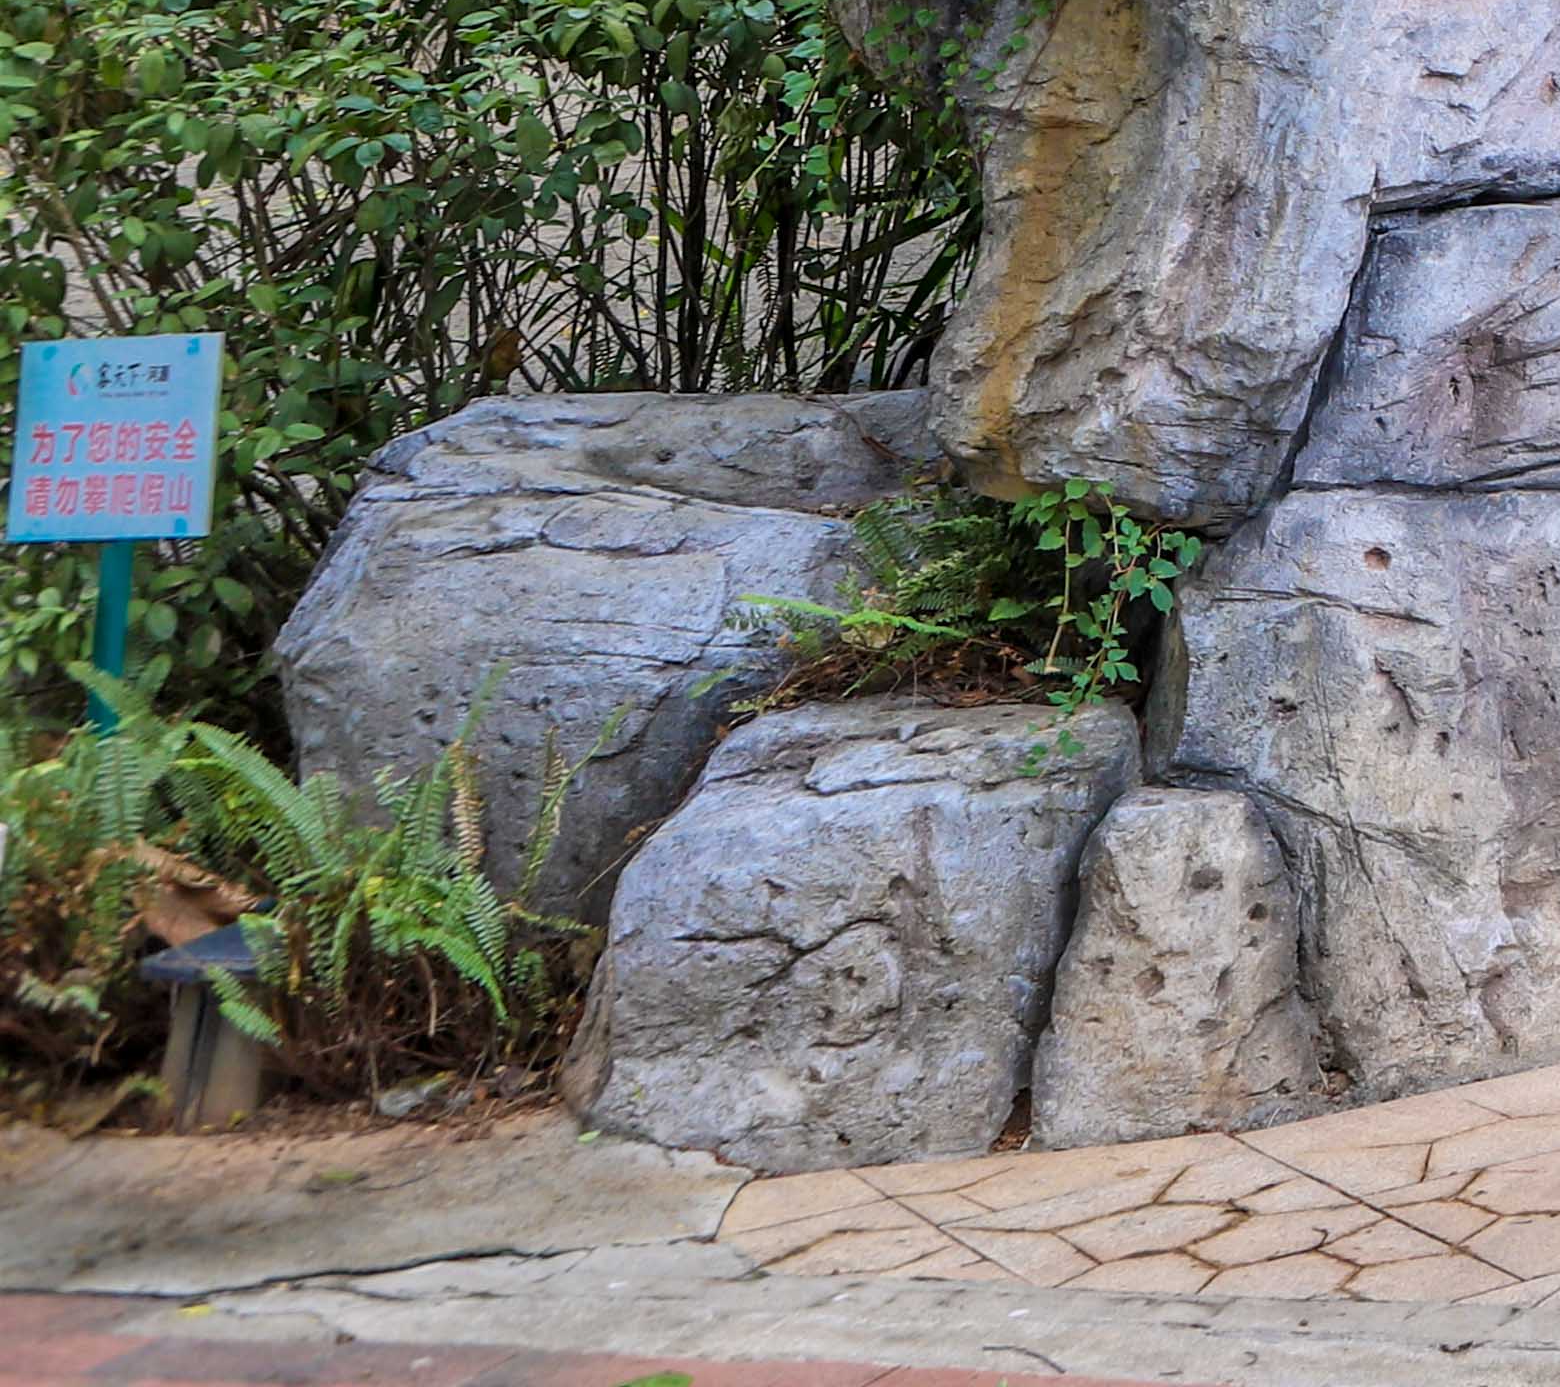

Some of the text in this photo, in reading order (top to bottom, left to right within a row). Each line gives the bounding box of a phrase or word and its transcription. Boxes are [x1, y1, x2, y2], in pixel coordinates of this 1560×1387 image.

[29, 419, 198, 463] 为了您的安全
